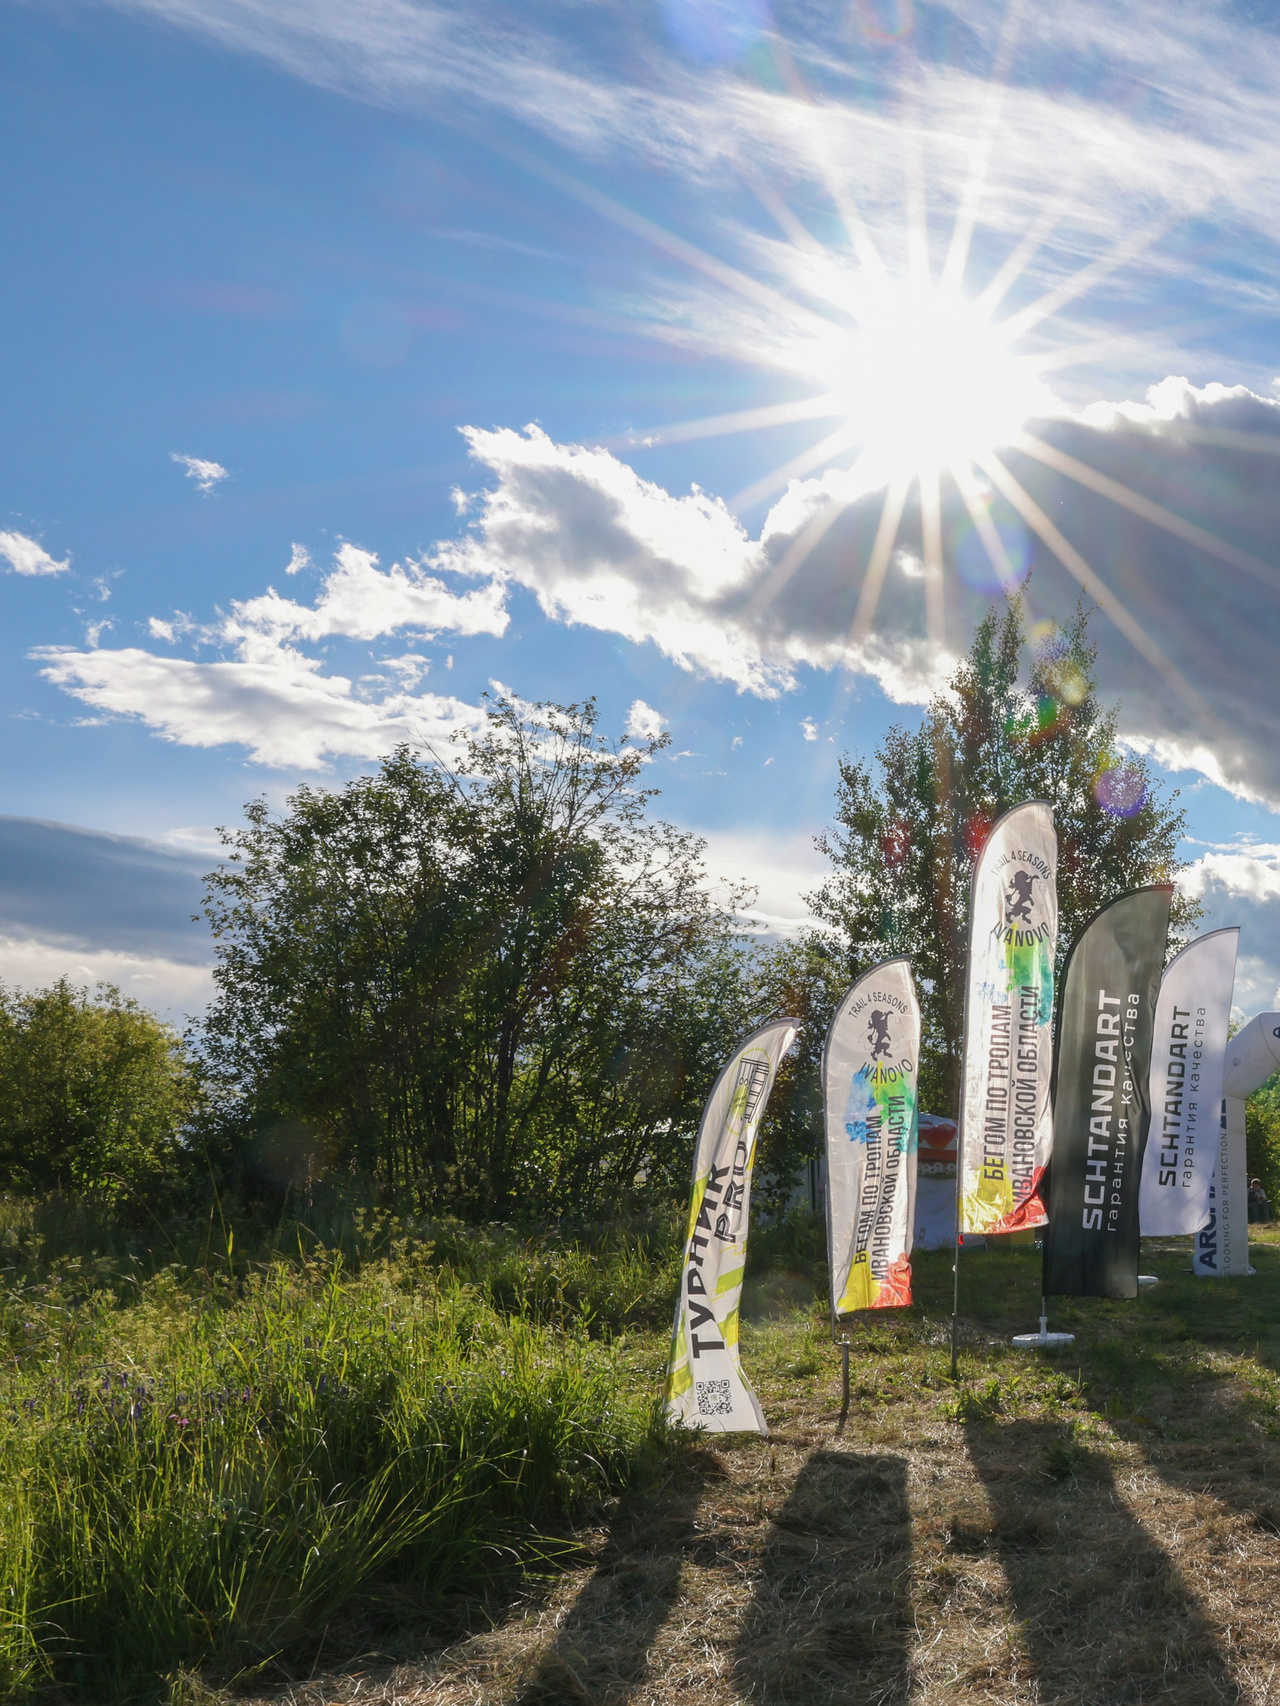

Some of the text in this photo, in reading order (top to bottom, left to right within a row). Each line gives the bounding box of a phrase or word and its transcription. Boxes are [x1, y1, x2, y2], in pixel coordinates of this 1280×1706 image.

[990, 920, 1050, 947] IVANOVO
[1011, 850, 1016, 861] 4
[1017, 850, 1052, 880] SEASONS
[848, 991, 908, 1019] TRAIL 4 SEASONS
[857, 1058, 913, 1084] IVANOVO
[983, 1004, 1012, 1181] БЕГОМ ПО ТРОПАМ
[1011, 985, 1039, 1203] ИВАНОВСКОЙ ОБЛАСТИ
[1082, 989, 1121, 1231] SCHTANDART
[1159, 1005, 1191, 1187] SCHTANDART
[1182, 1007, 1206, 1188] гарантия качества
[714, 1140, 747, 1243] PRO
[854, 1115, 882, 1264] БЕГОМ ПО ТРОПАМ
[871, 1095, 905, 1281] ИВАНОВСКОЙ ОБЛАСТИ
[1107, 1118, 1128, 1232] гарантия
[1220, 1133, 1231, 1269] LOOKING FOR PERFECTION
[687, 1162, 731, 1359] ТУРНИК
